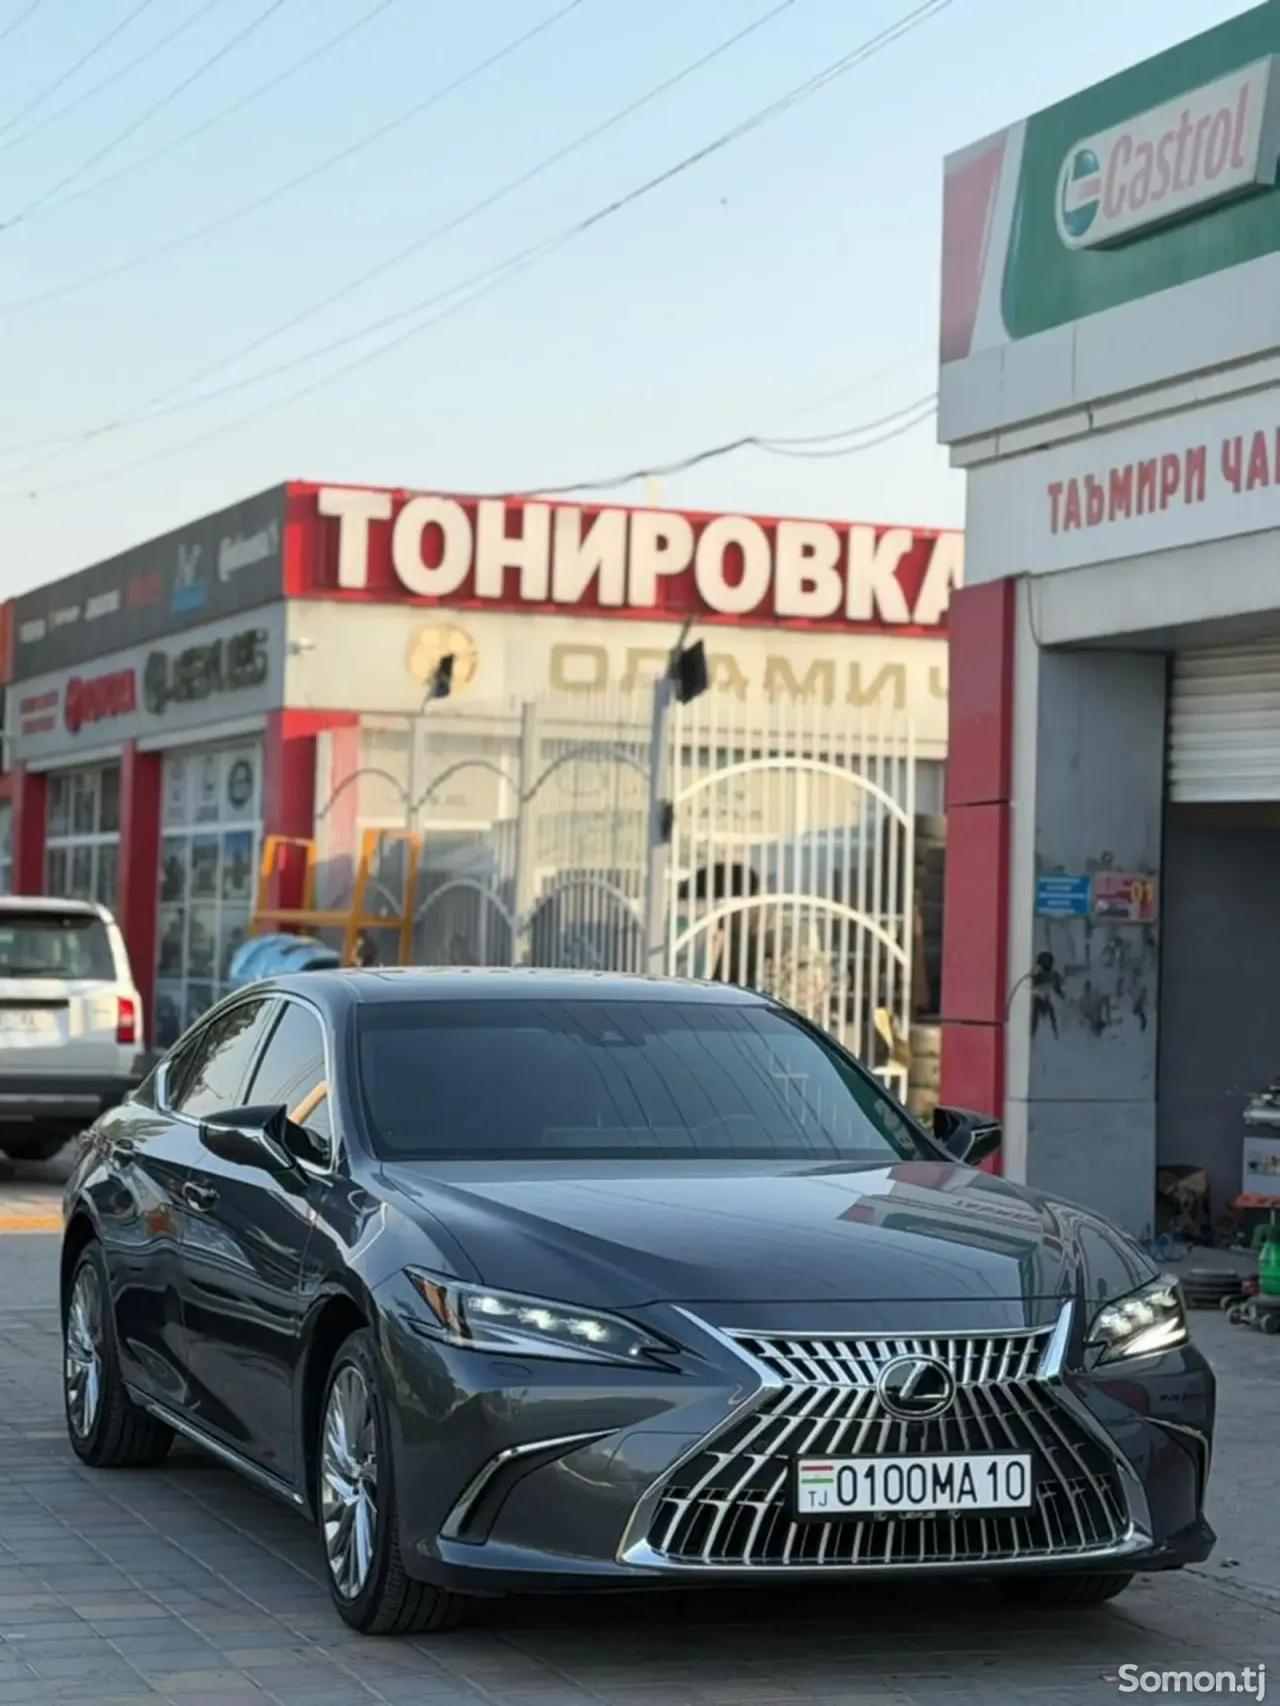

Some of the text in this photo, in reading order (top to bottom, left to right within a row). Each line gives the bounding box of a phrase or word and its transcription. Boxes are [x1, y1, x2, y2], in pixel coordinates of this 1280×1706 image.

[1103, 82, 1249, 219] Castrol
[1048, 427, 1280, 534] ТАЪМИРИ ЧА
[808, 1491, 828, 1508] TJ
[837, 1461, 1025, 1506] 0100MA 10
